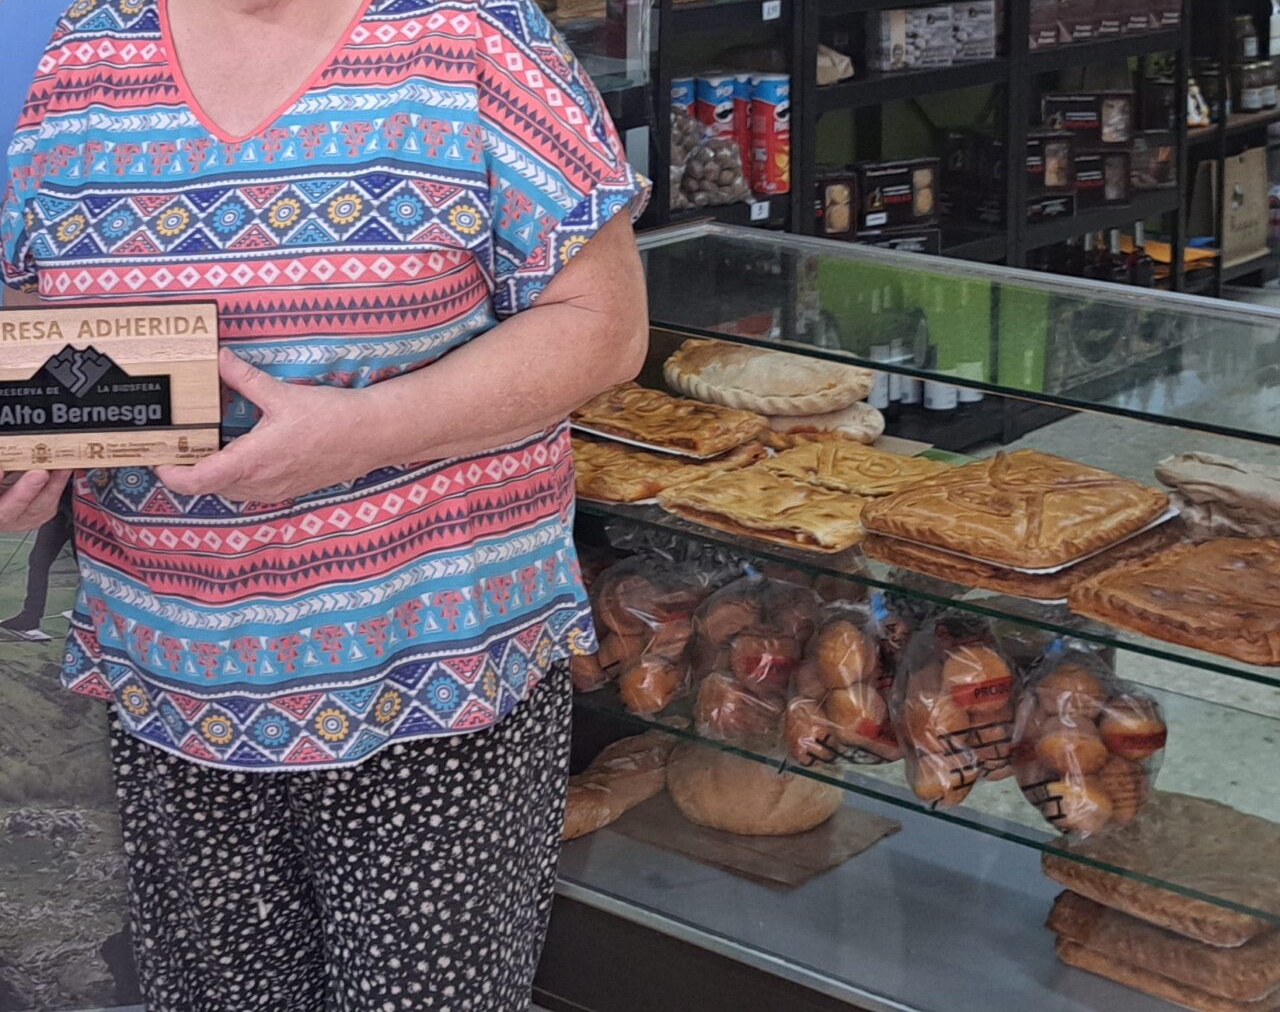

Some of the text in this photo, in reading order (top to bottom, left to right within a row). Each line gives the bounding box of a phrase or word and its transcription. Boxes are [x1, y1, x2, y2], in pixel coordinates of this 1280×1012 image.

[78, 315, 209, 338] ADHERIDA
[46, 387, 59, 395] DE
[98, 385, 110, 393] LA
[113, 383, 161, 392] BIOSFERA
[0, 403, 162, 425] Alto Bernesga
